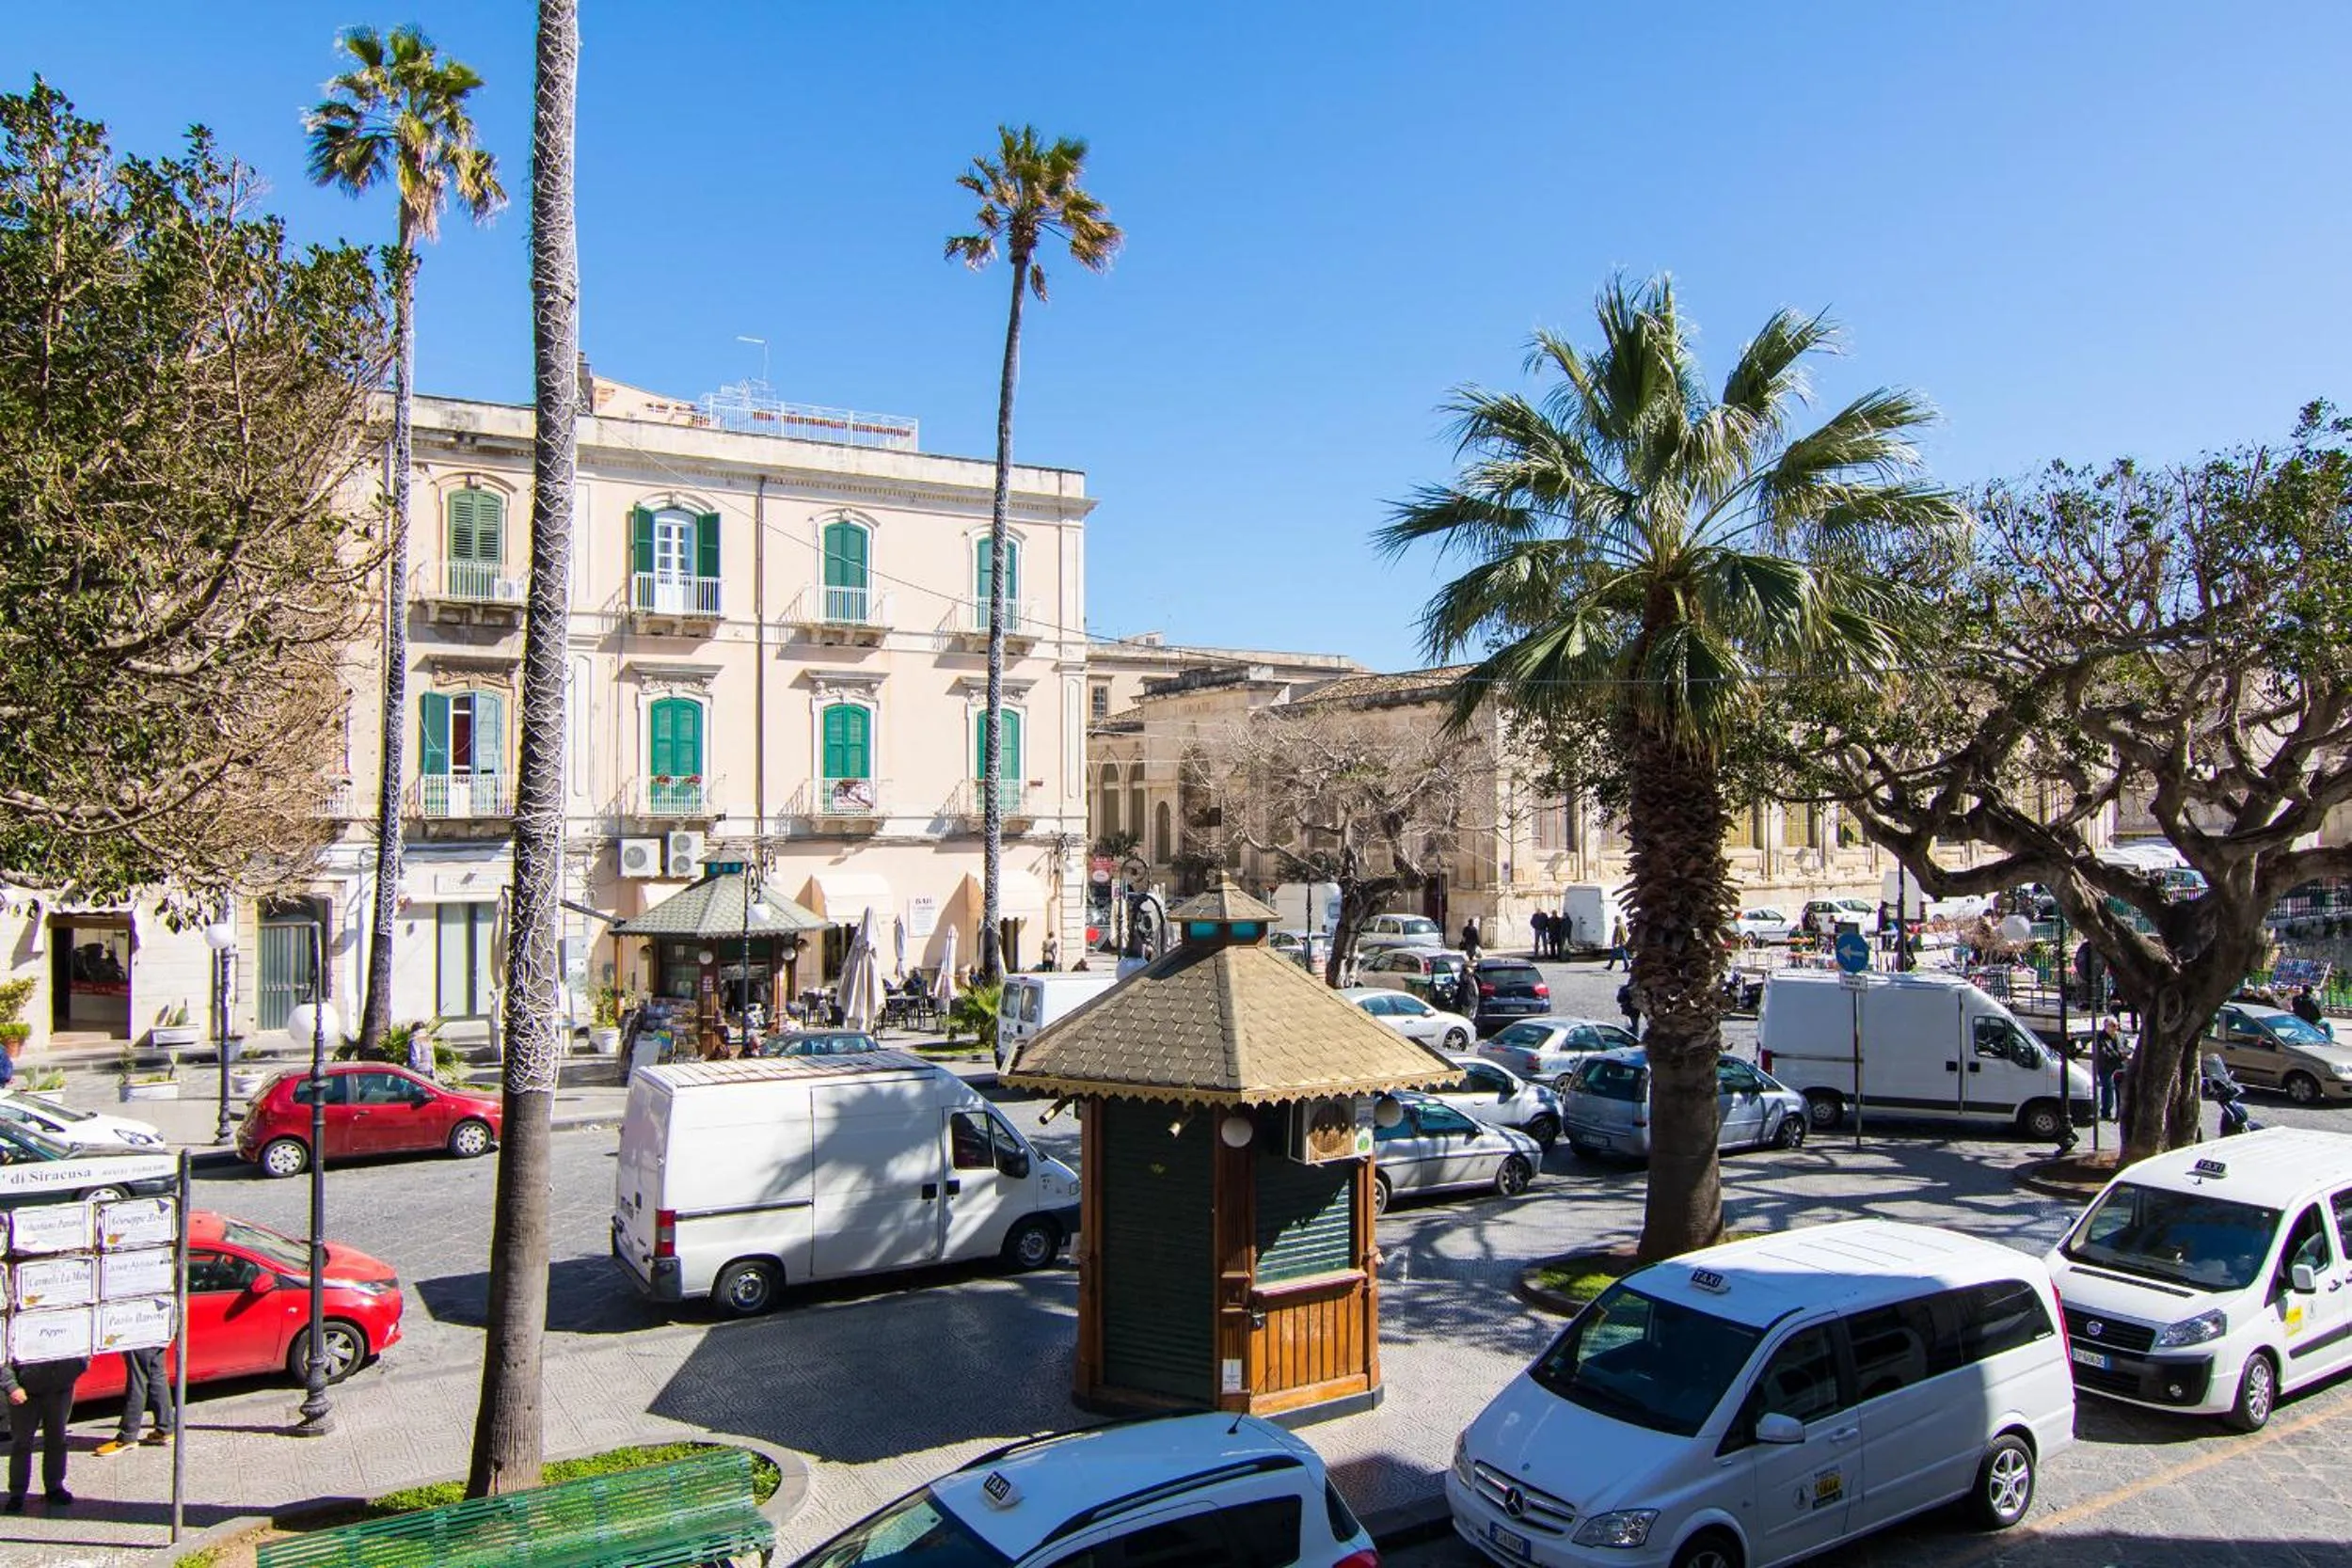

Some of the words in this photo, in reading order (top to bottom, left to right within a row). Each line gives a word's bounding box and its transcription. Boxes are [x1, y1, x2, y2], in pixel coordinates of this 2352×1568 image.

[2199, 1160, 2224, 1173] TAXI
[10, 1171, 24, 1185] di
[29, 1168, 93, 1183] Siracusa
[1694, 1270, 1721, 1286] TAXI
[986, 1473, 1009, 1499] TAXI
